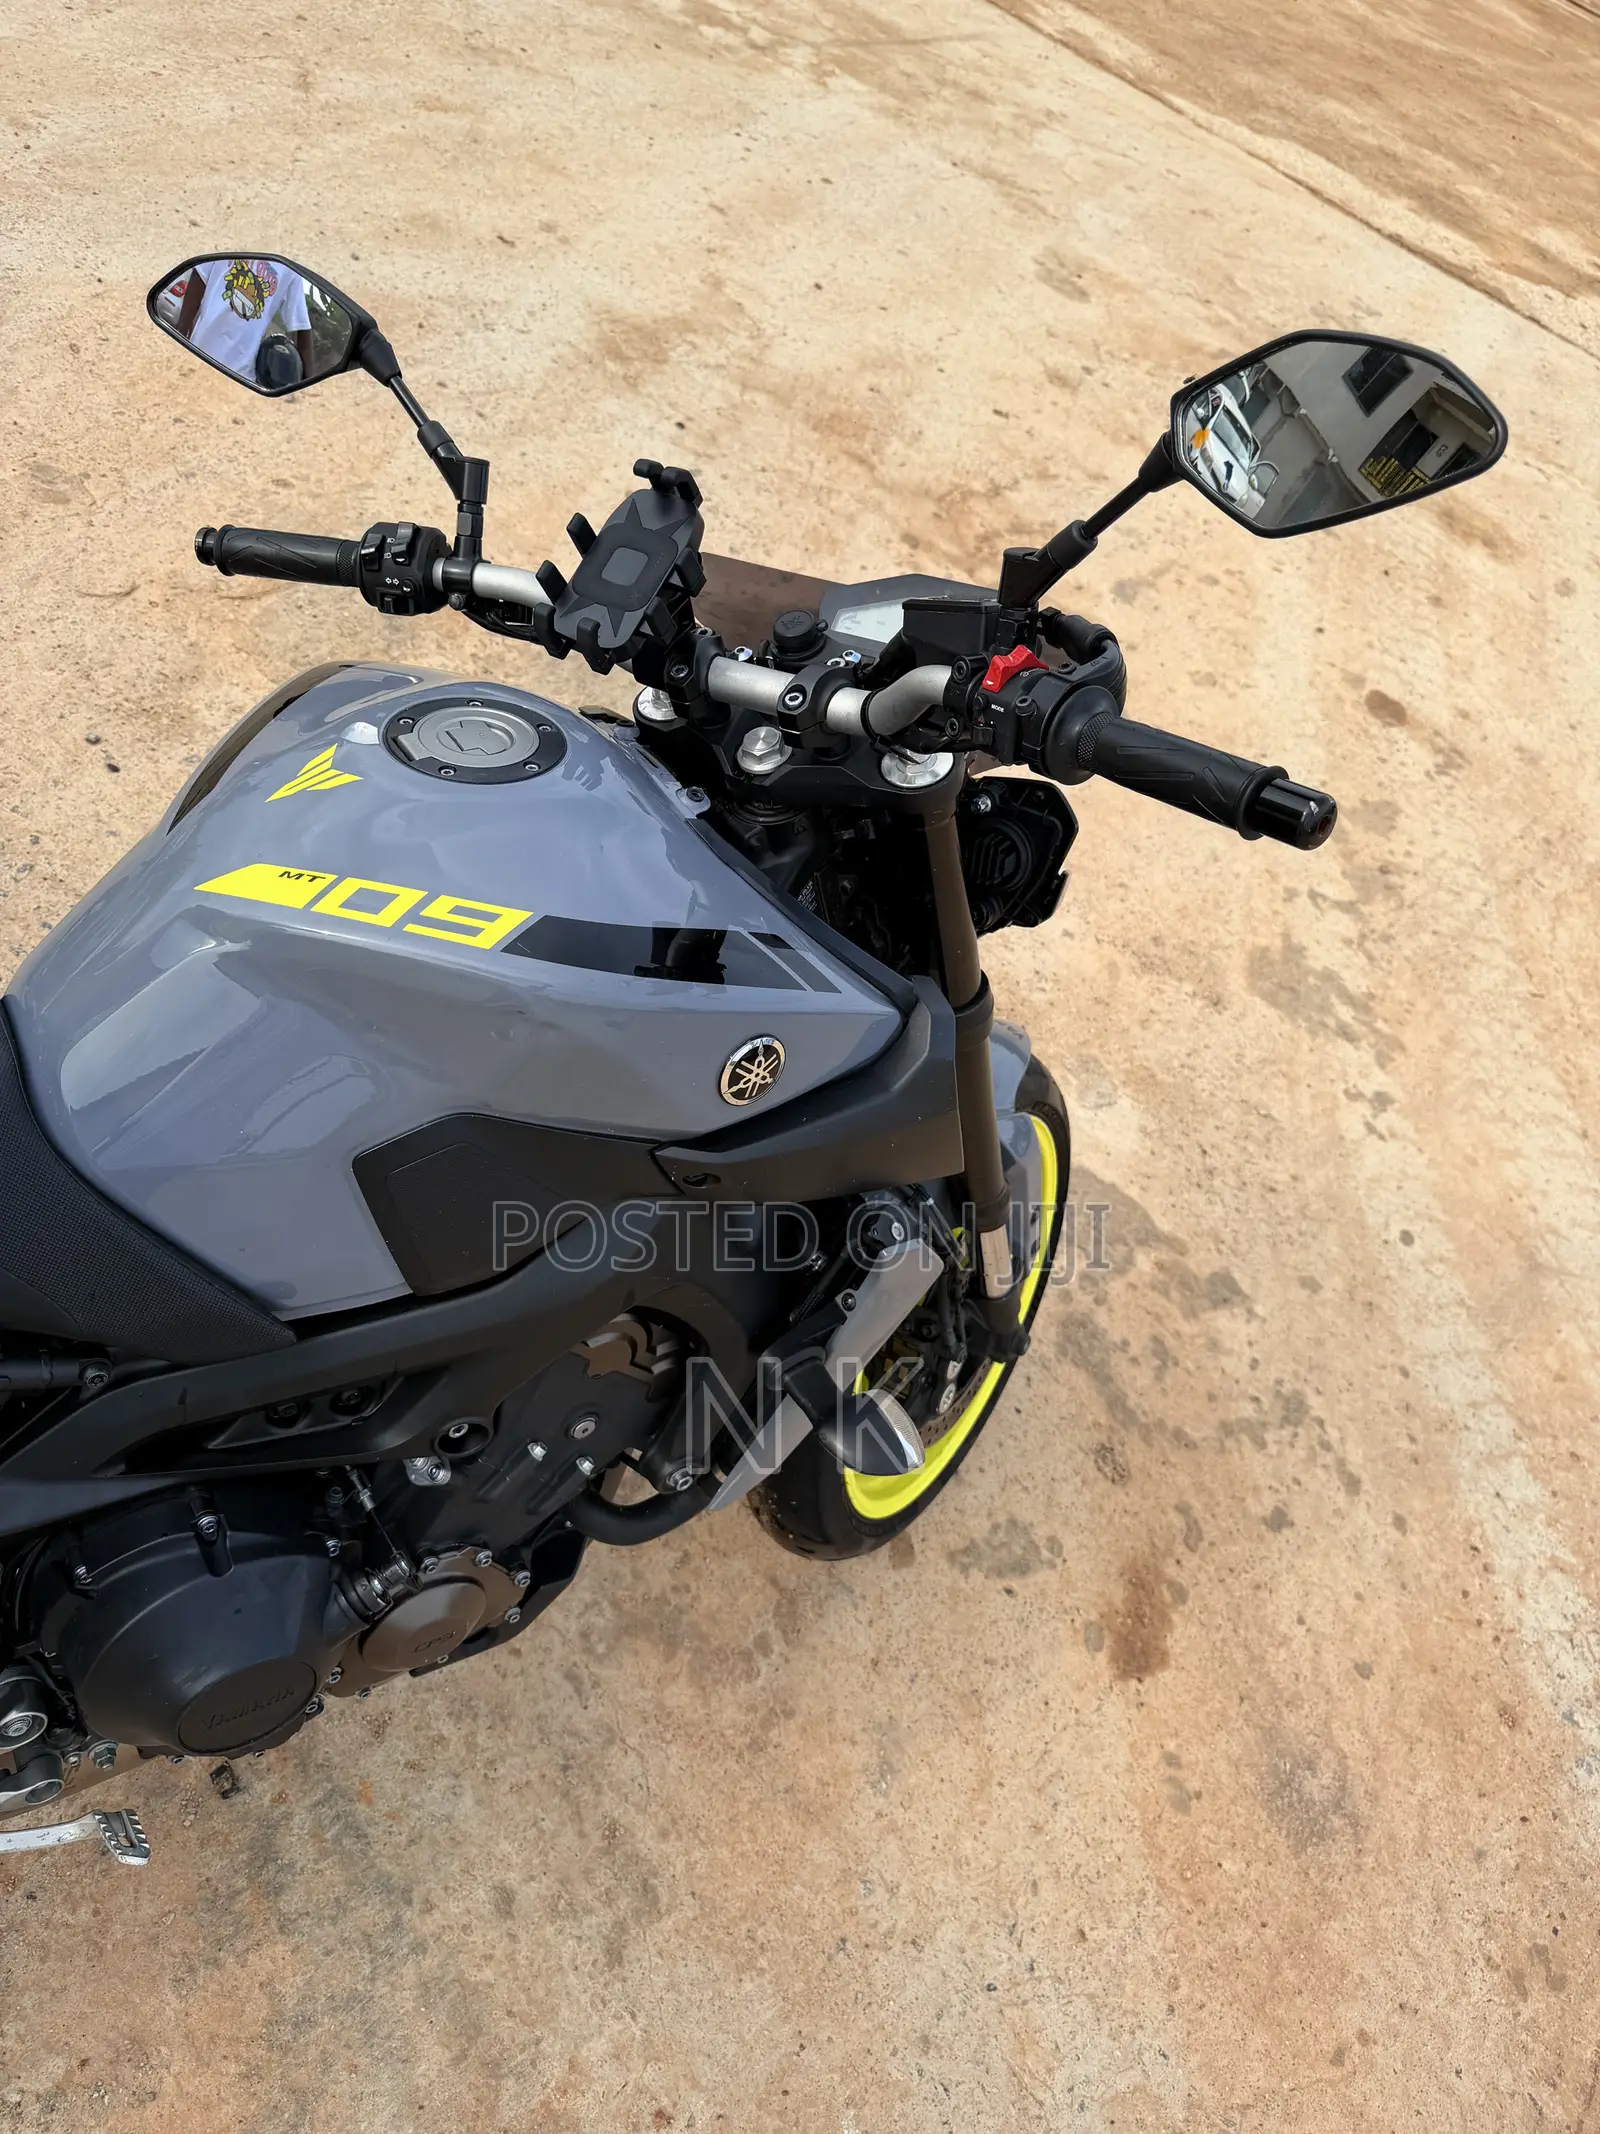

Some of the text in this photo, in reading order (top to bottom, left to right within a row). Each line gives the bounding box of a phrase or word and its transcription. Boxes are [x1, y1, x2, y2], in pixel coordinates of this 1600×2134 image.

[991, 703, 1005, 713] MODE
[278, 870, 534, 950] MT 09
[200, 1685, 297, 1730] YAMAHA
